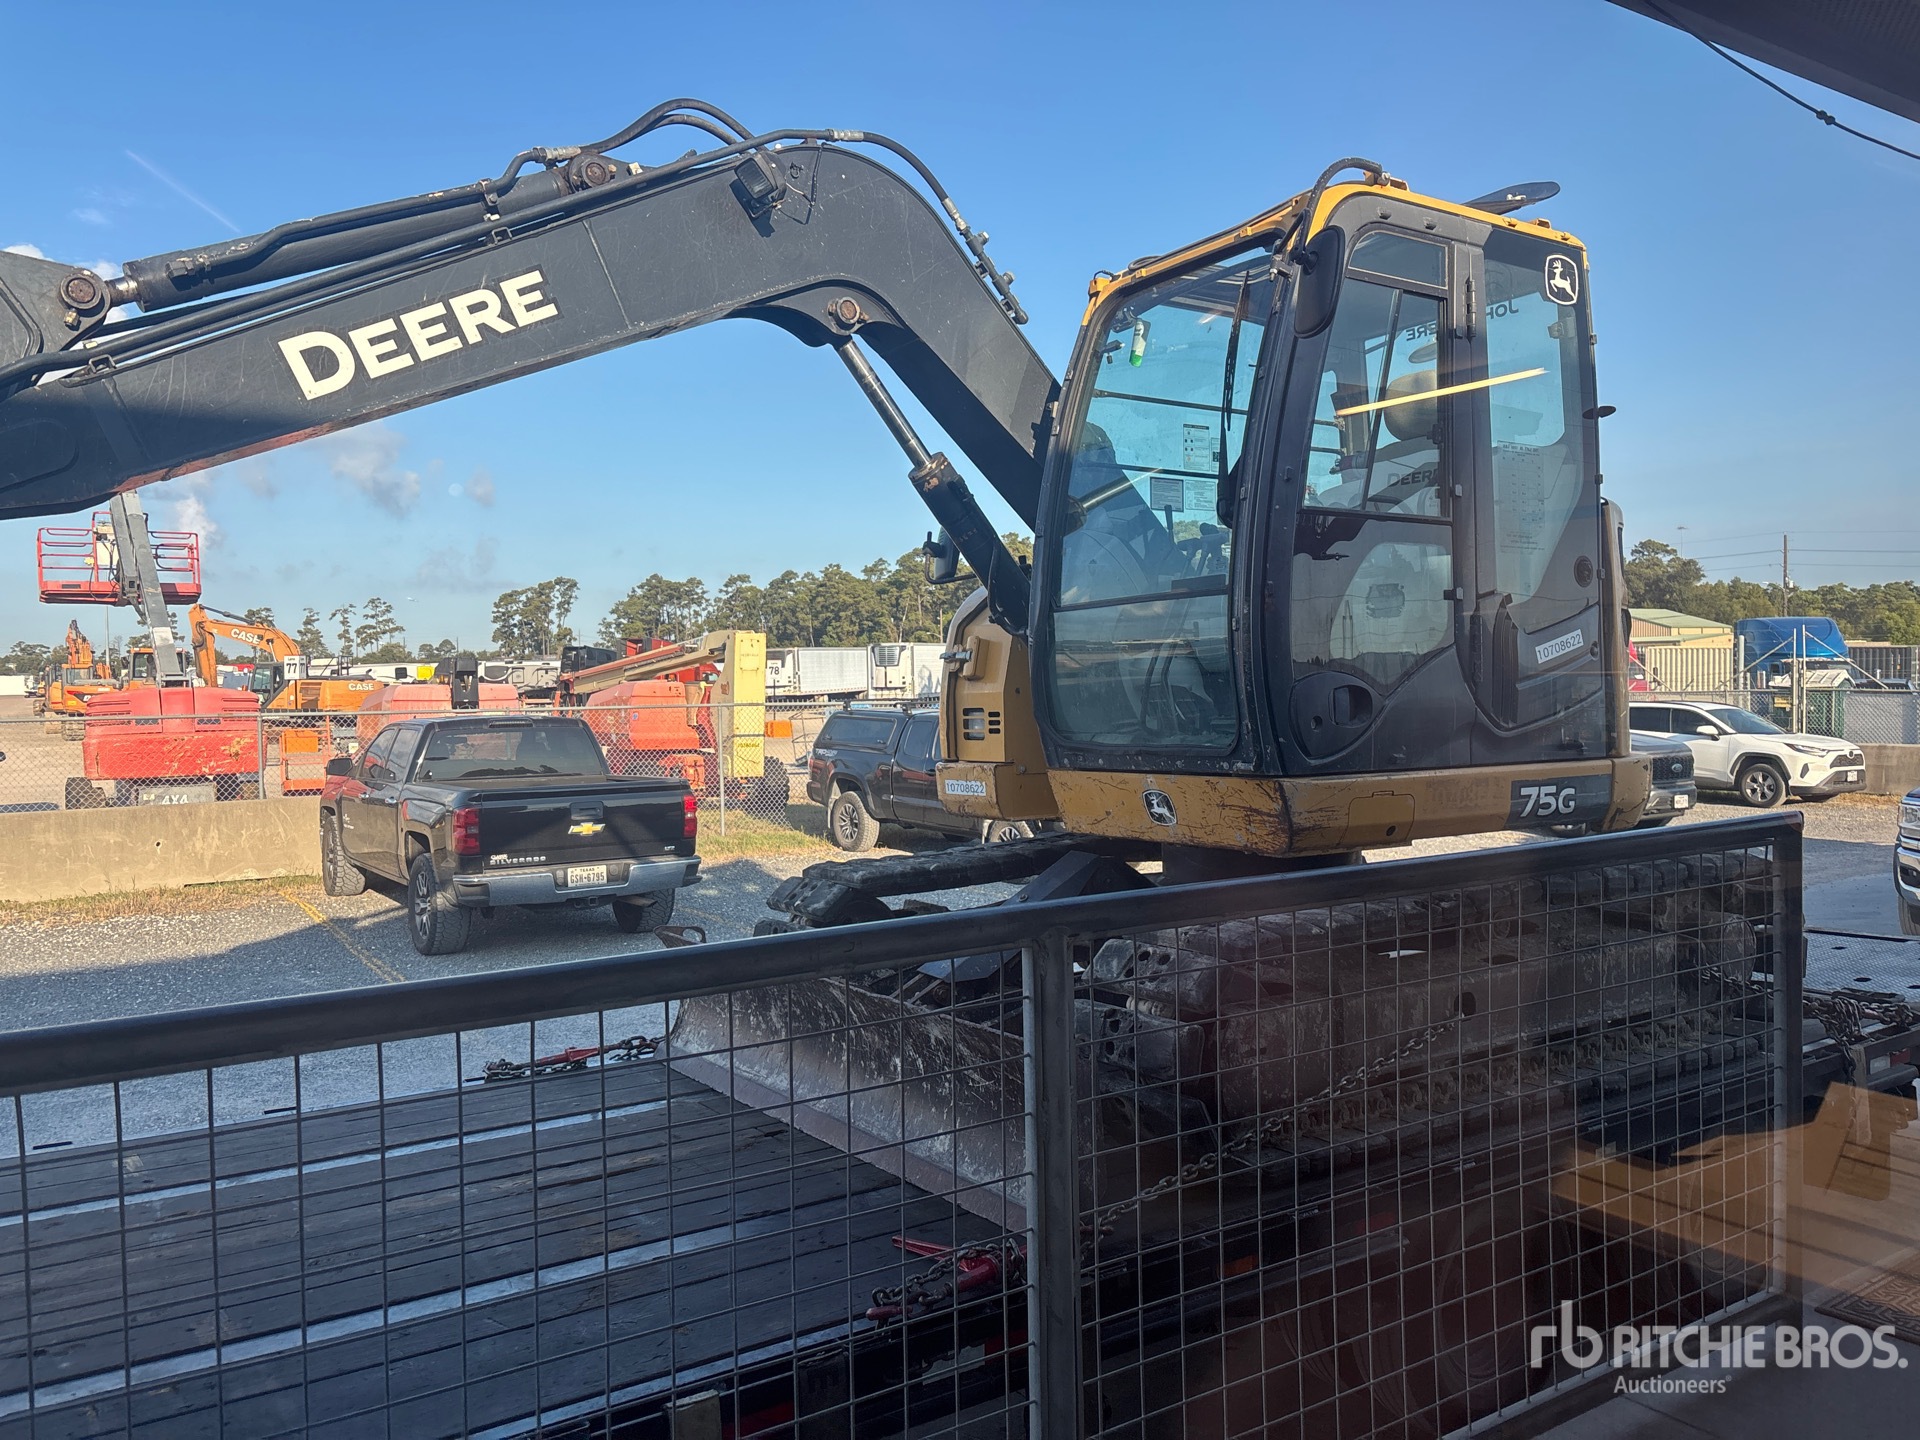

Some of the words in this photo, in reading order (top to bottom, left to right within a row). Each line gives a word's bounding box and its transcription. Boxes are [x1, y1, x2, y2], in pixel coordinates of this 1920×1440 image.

[278, 270, 559, 401] DEERE
[230, 628, 261, 645] CASE
[1536, 634, 1583, 660] 10708622
[286, 663, 298, 674] 77
[769, 666, 780, 675] 78
[348, 683, 375, 691] CASE
[946, 782, 985, 794] 10708622
[1520, 785, 1575, 818] 75G
